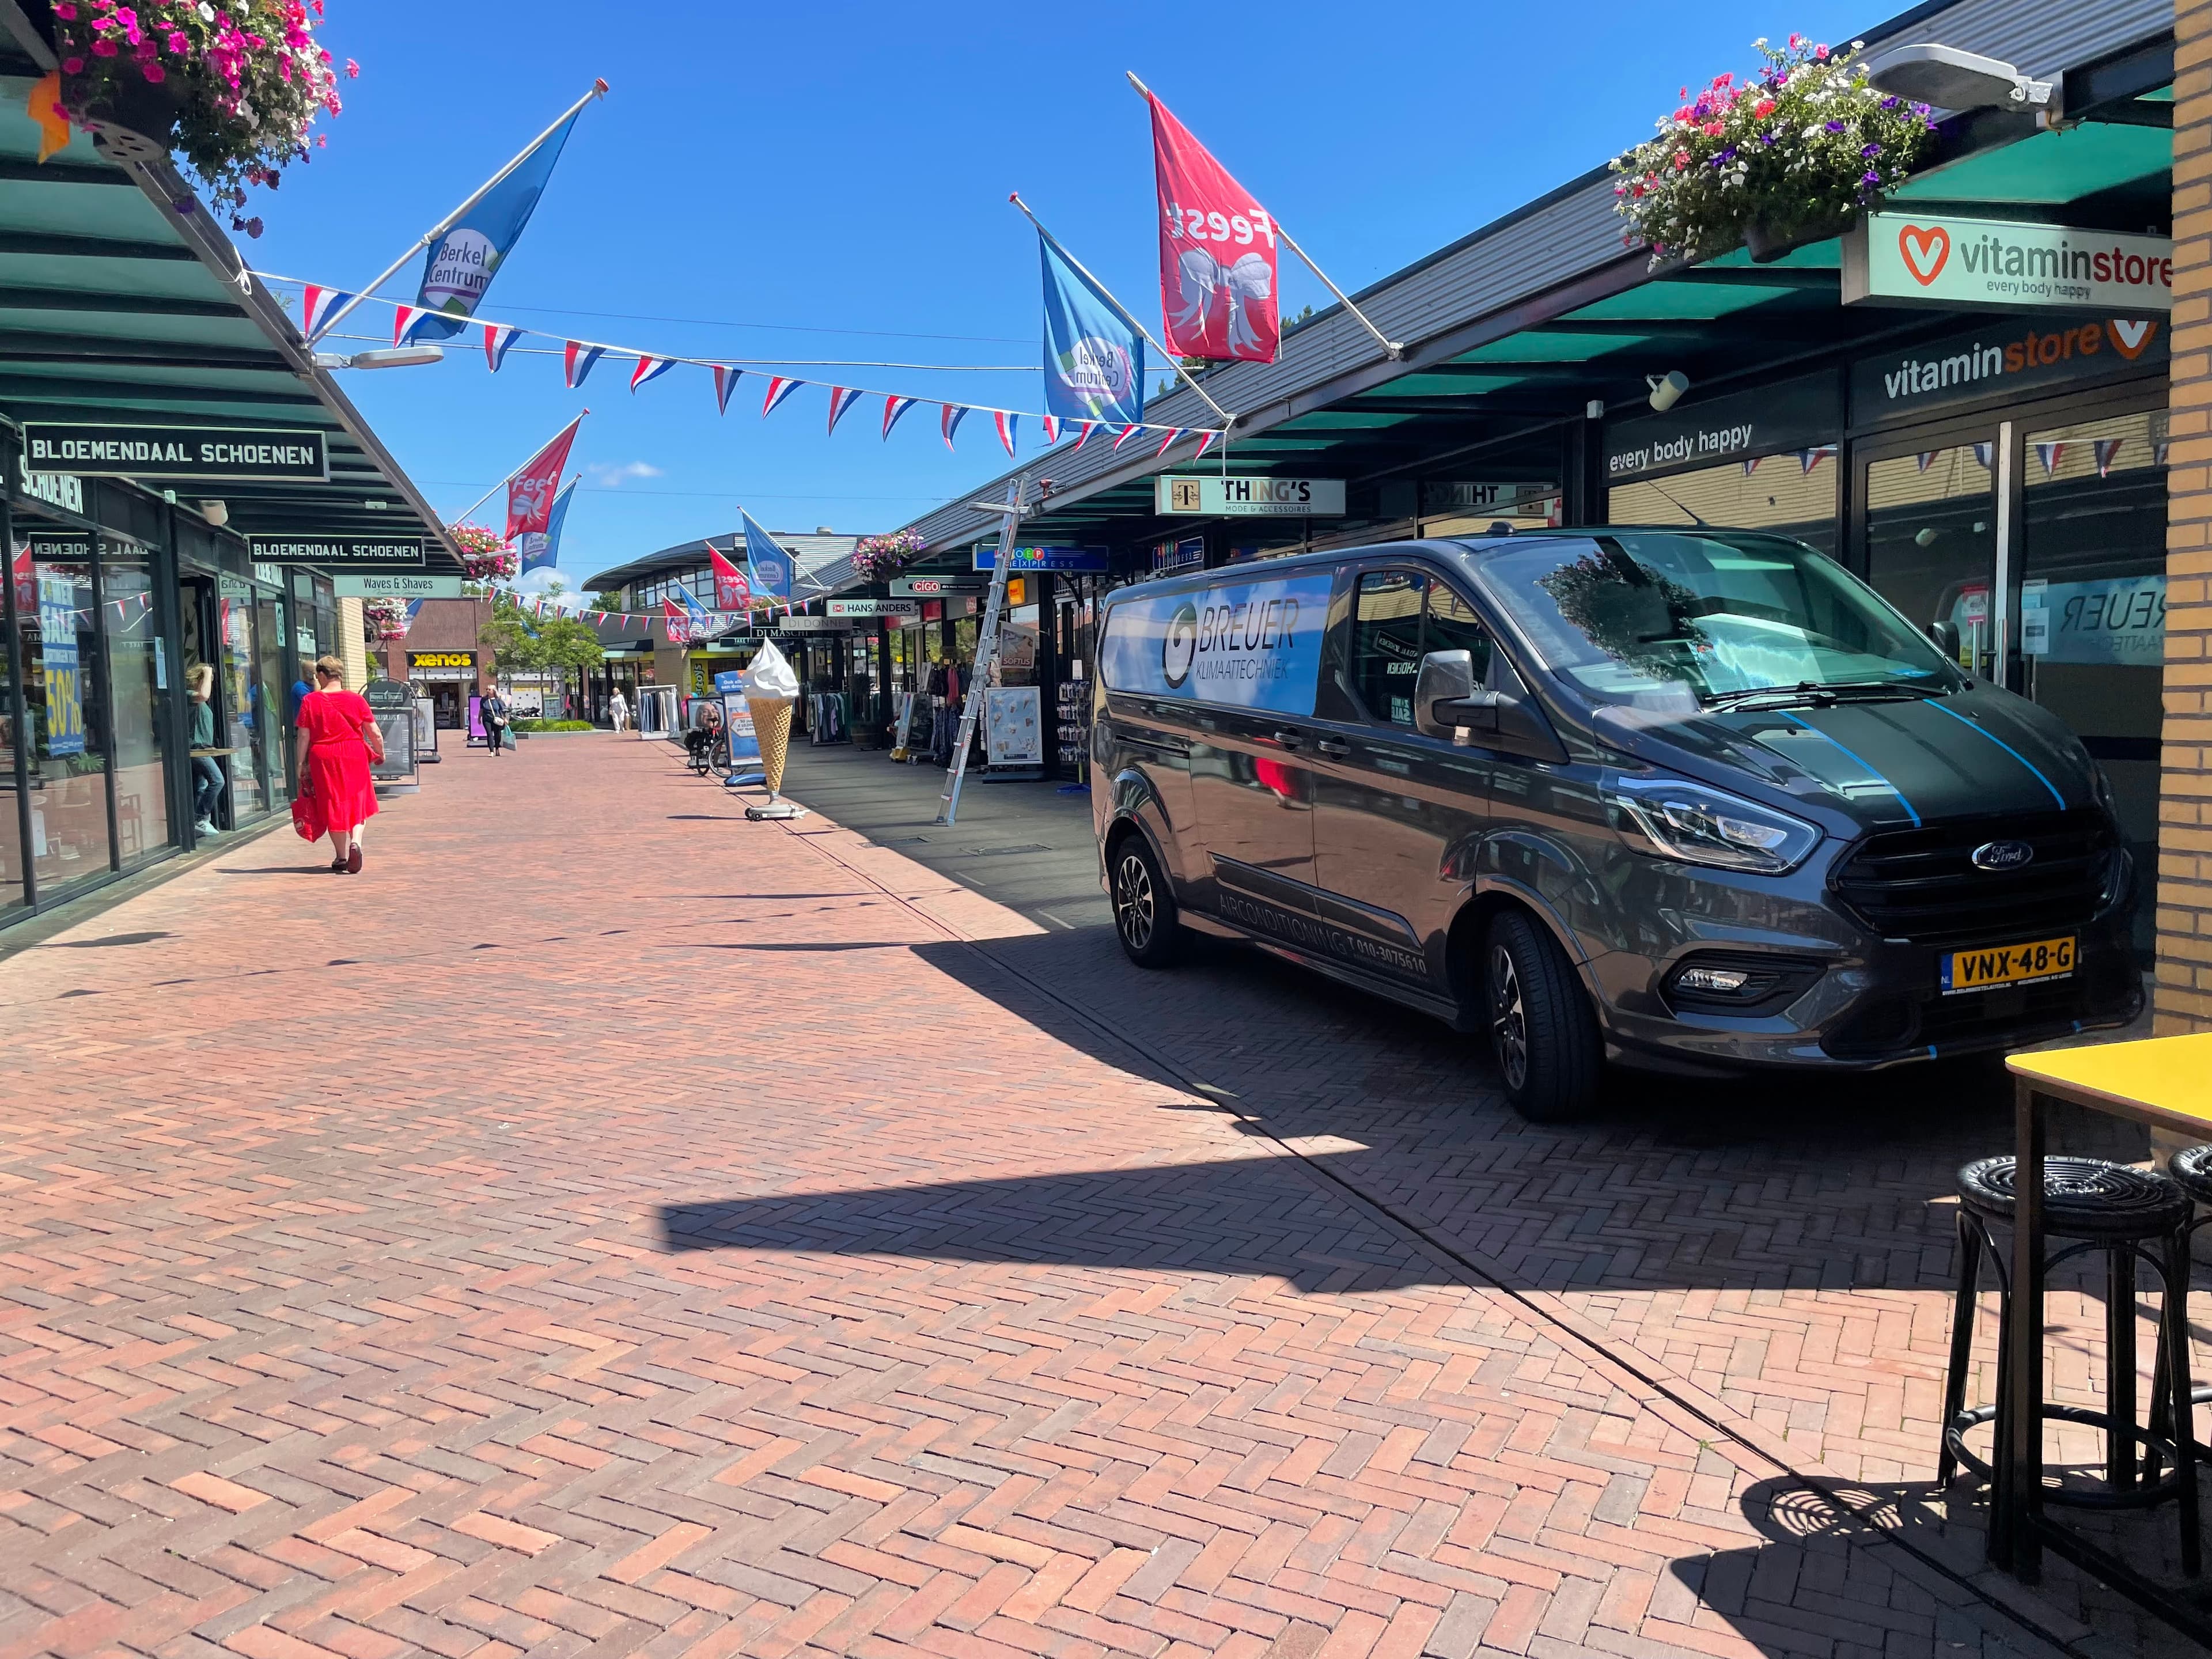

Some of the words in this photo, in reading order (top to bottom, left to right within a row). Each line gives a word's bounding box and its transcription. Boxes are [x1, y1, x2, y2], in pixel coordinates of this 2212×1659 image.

[440, 242, 487, 267] Berkel
[1961, 234, 2173, 287] vitaminstore
[429, 264, 488, 290] Centrum
[1987, 280, 2019, 296] every
[2022, 281, 2052, 297] body
[2054, 283, 2092, 300] happy
[1884, 323, 2103, 399] vitaminstore
[32, 440, 192, 461] BLOEMENDAAL
[201, 444, 314, 465] SCHOENEN
[1609, 448, 1649, 471] every
[1654, 435, 1694, 462] body
[1698, 424, 1752, 453] happy
[1221, 480, 1311, 502] THING'S
[253, 543, 348, 556] BLOEMENDAAL
[352, 545, 419, 557] SCHOENEN
[363, 578, 391, 589] Waves
[393, 578, 400, 589] &
[402, 578, 433, 589] Shaves
[915, 579, 939, 591] CIGO
[847, 604, 873, 612] HANS
[875, 604, 911, 612] ANDERS
[804, 619, 845, 627] DONNE
[1199, 598, 1300, 652] BREUER
[413, 653, 471, 667] xenos
[1196, 658, 1291, 680] KLIMAATTECHNIEK
[46, 669, 81, 738] 50%
[1987, 845, 2023, 863] Ford
[1219, 893, 1348, 955] AIRCONDITIONING
[1357, 939, 1427, 974] 010-3075610
[1962, 941, 2070, 982] VNX-48-G
[1941, 975, 1950, 984] NL
